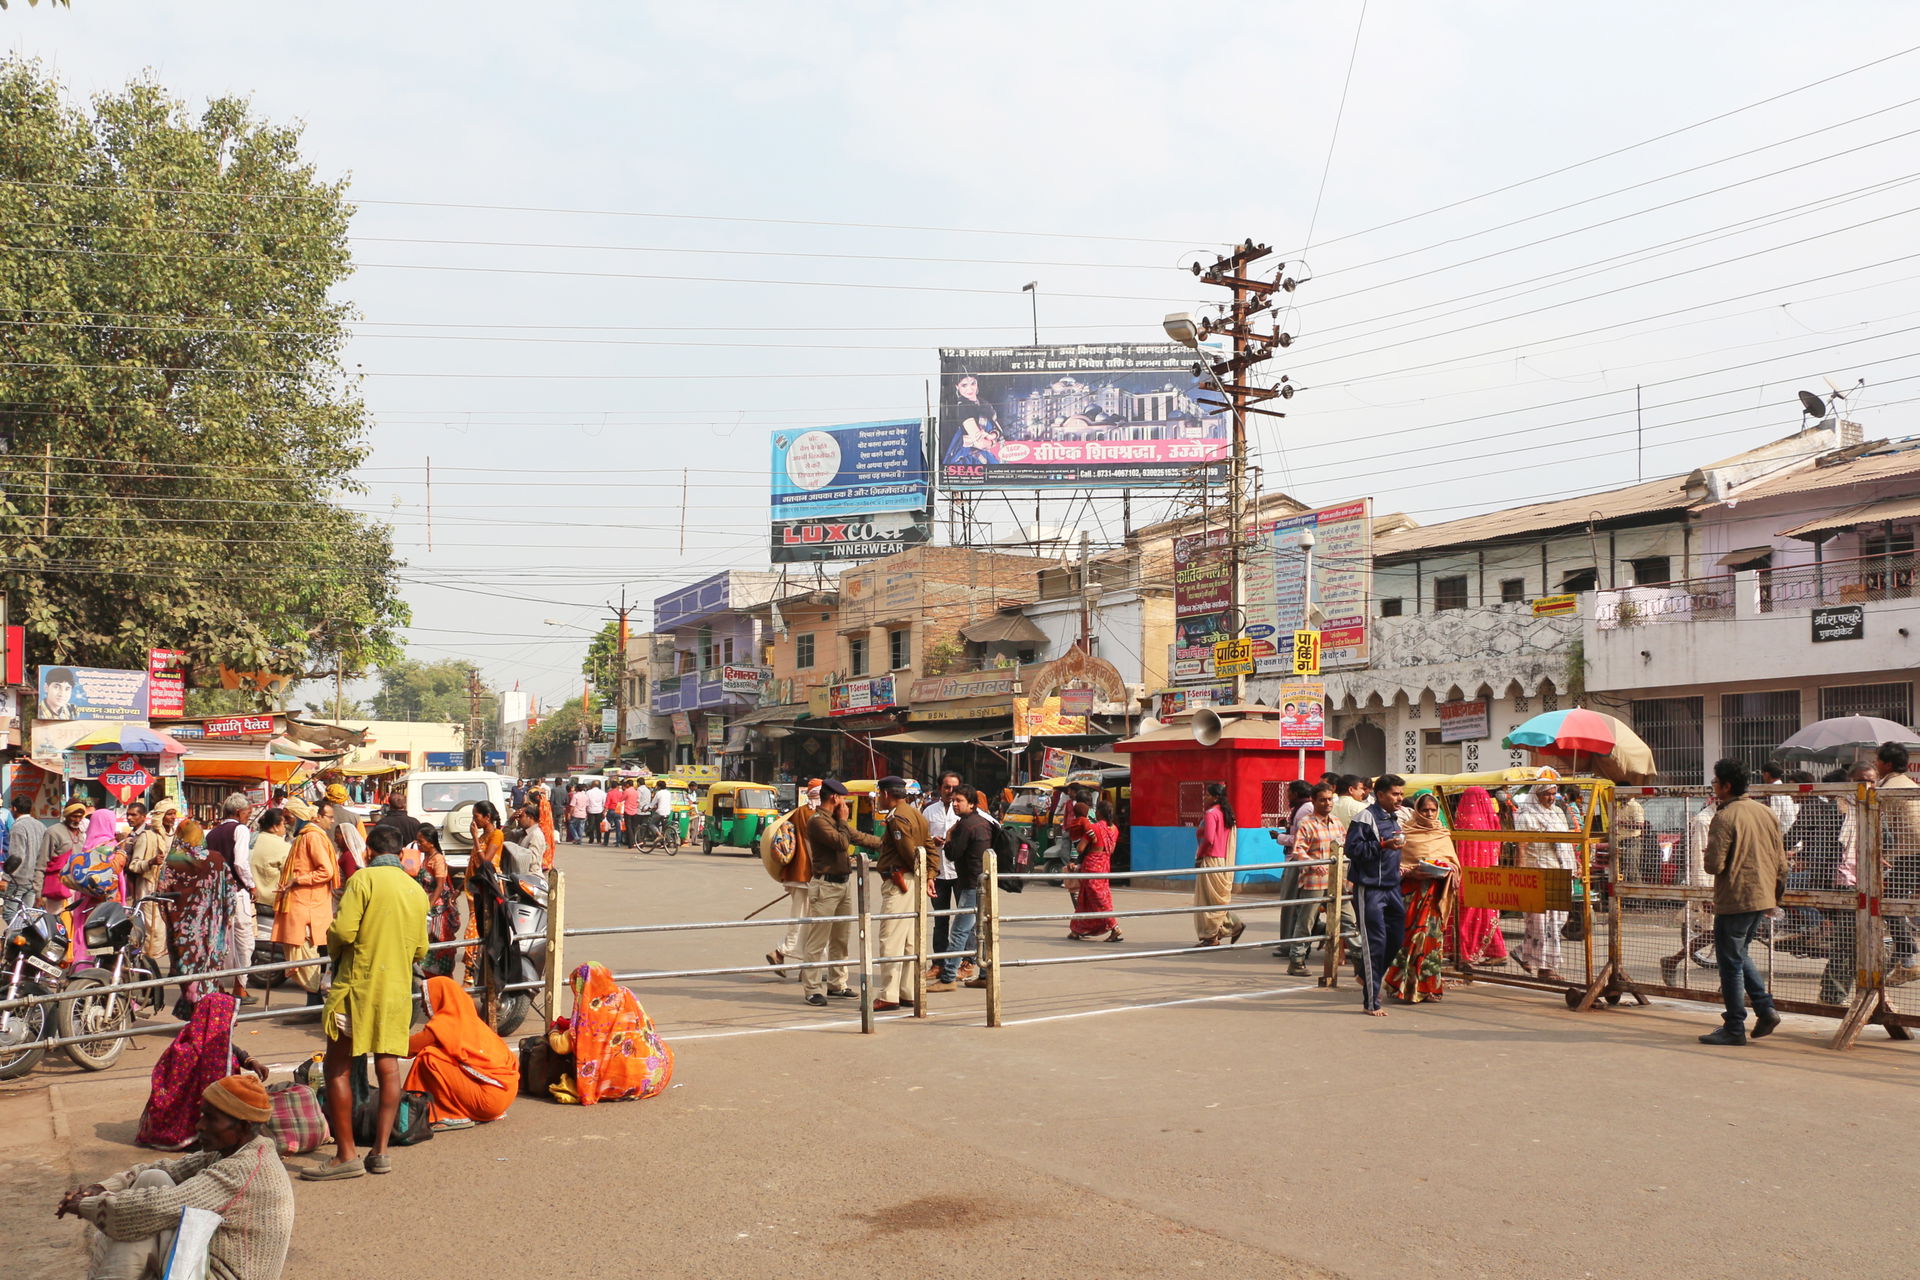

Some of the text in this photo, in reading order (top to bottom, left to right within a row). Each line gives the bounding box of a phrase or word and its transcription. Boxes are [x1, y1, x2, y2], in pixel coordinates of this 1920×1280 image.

[1024, 361, 1035, 369] 12
[947, 465, 984, 477] SEAC
[783, 525, 848, 544] LUX
[832, 543, 904, 556] INNERWEAR
[725, 666, 758, 680] हिमालय
[1216, 662, 1252, 675] PARKING
[849, 683, 870, 692] T-Series
[944, 680, 1010, 697] भोजनालय
[1187, 689, 1211, 698] T-Series
[928, 711, 948, 720] BSNL
[969, 708, 997, 718] BSNL
[208, 718, 270, 734] प्रशांति पैलेस
[118, 757, 135, 771] दही
[1468, 871, 1538, 889] TRAFFIC POLICE
[1487, 892, 1520, 907] UJJAIN
